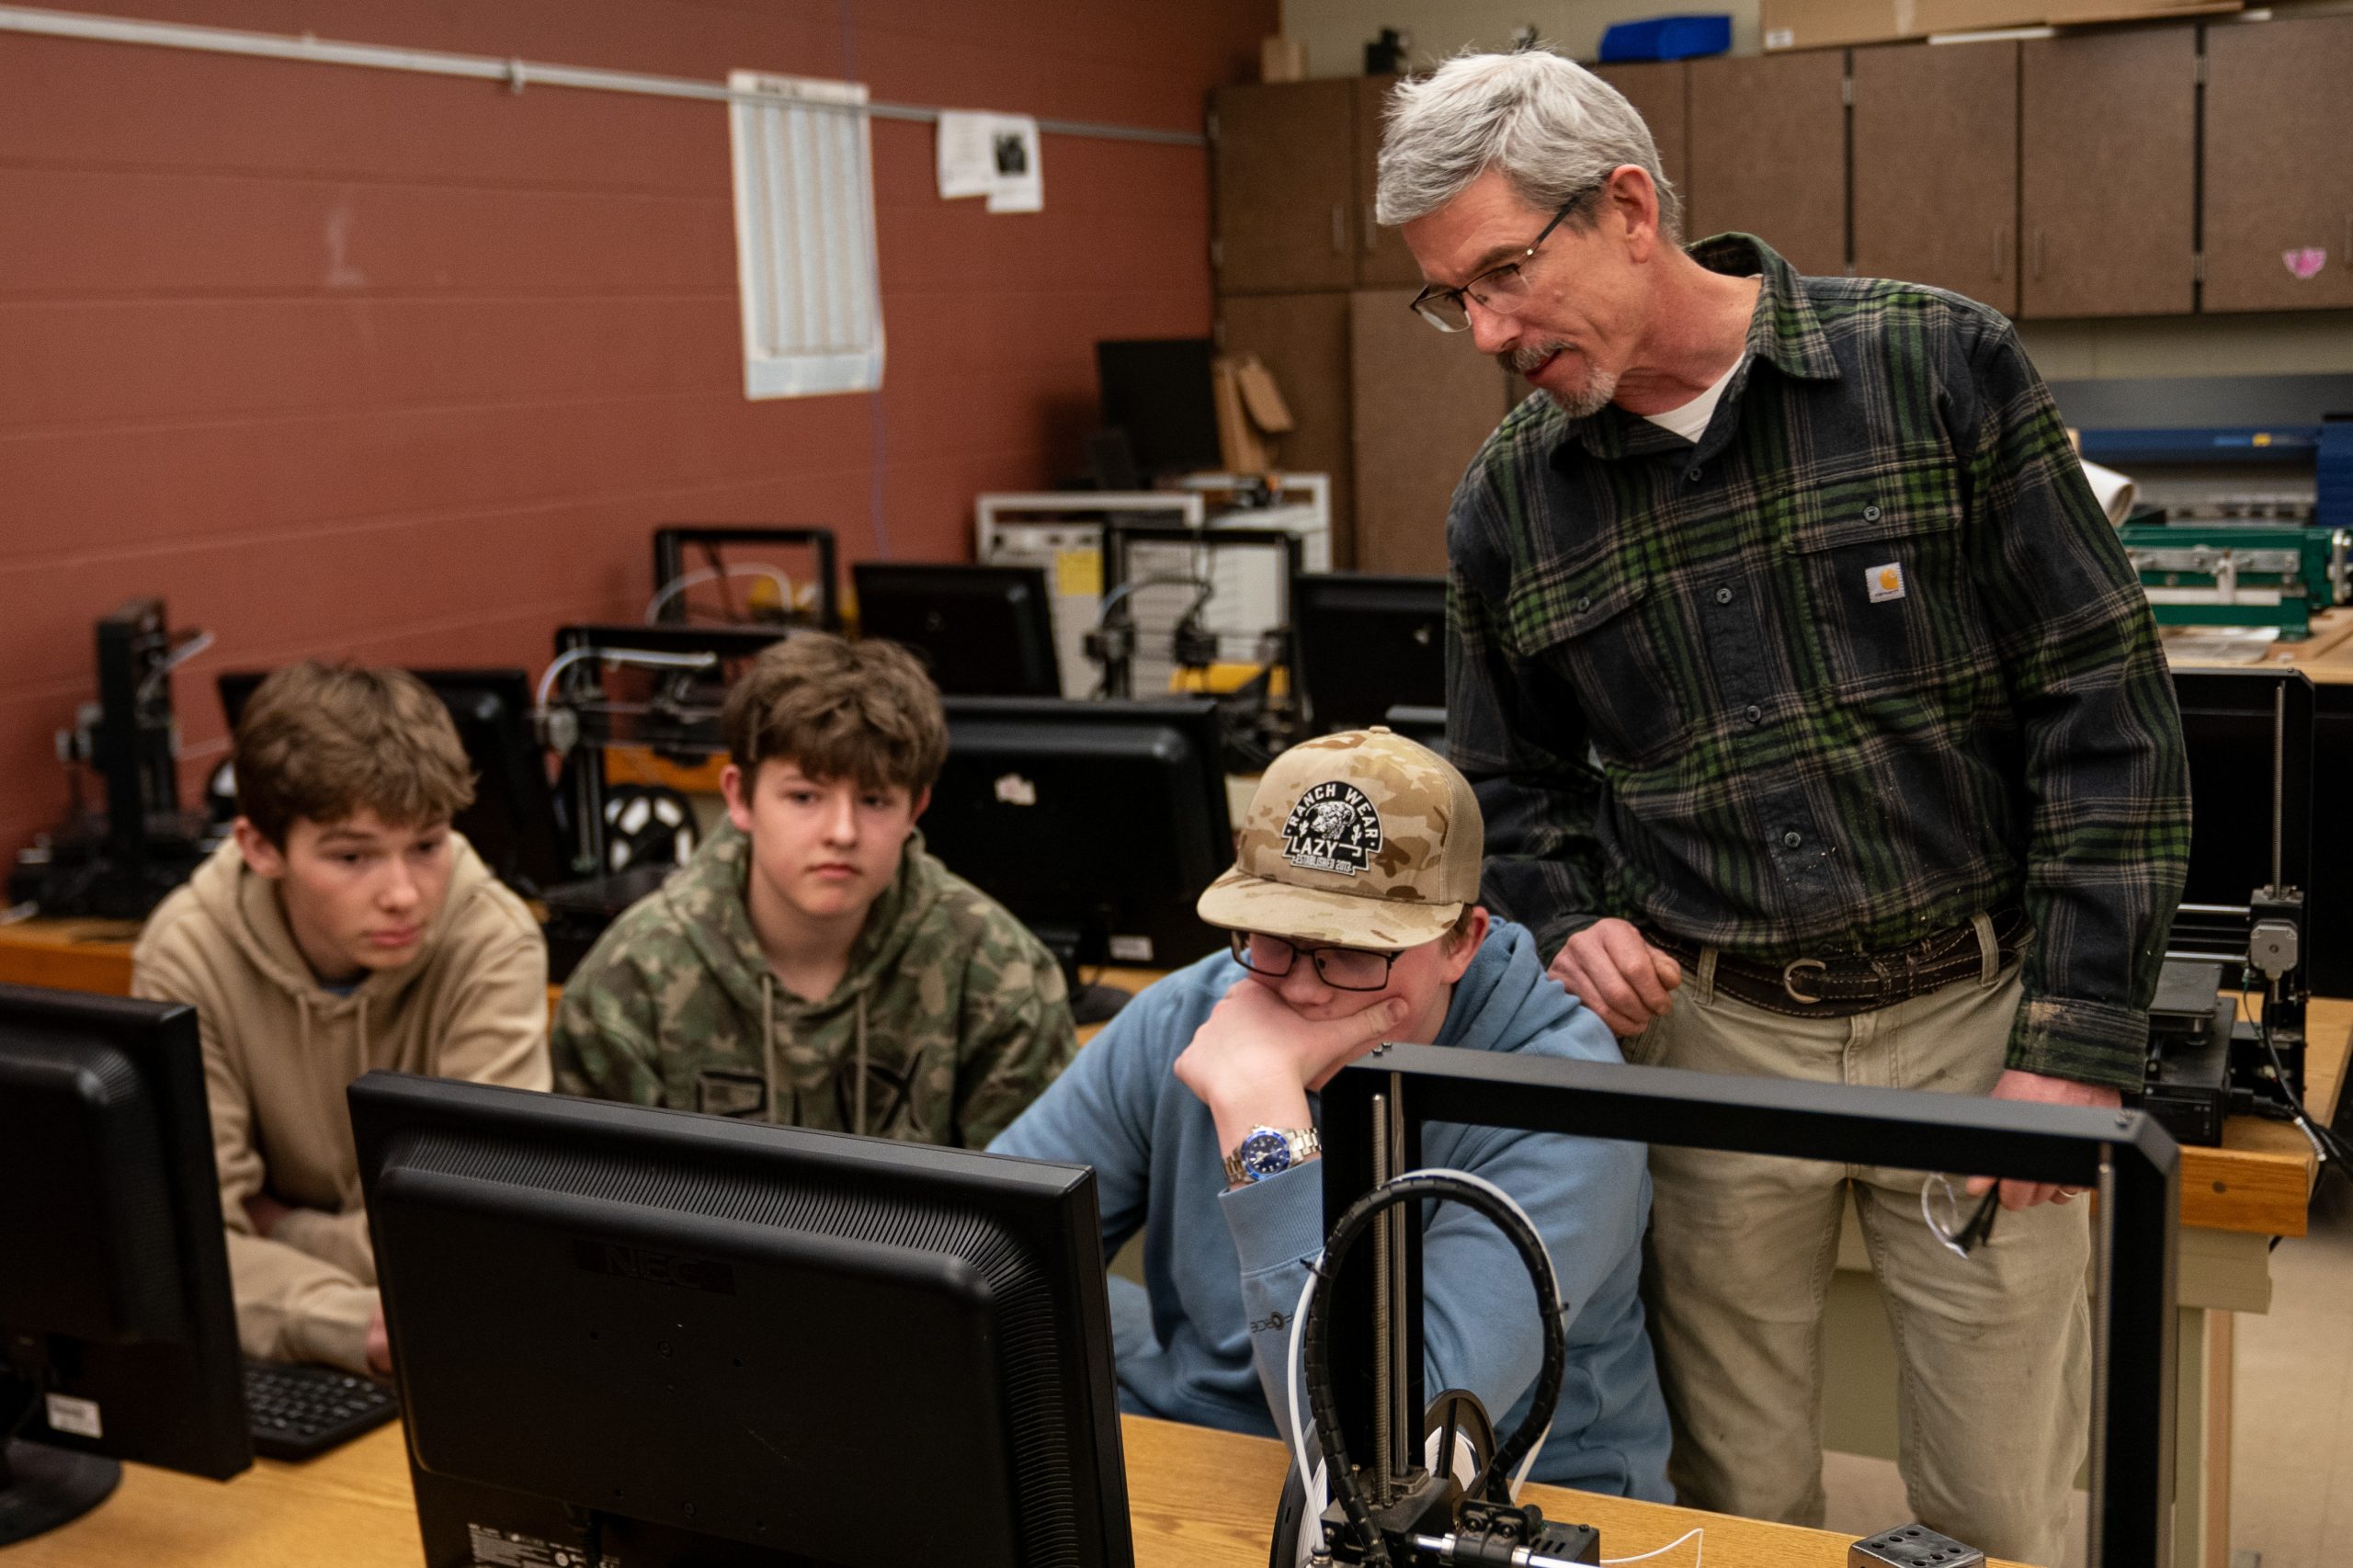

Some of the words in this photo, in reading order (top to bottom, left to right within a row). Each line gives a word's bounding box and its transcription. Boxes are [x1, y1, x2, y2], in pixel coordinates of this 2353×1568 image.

[1289, 783, 1336, 827] RANCH
[1345, 787, 1379, 838] WEAR
[1290, 835, 1338, 858] LAZY
[604, 1244, 704, 1290] NEC
